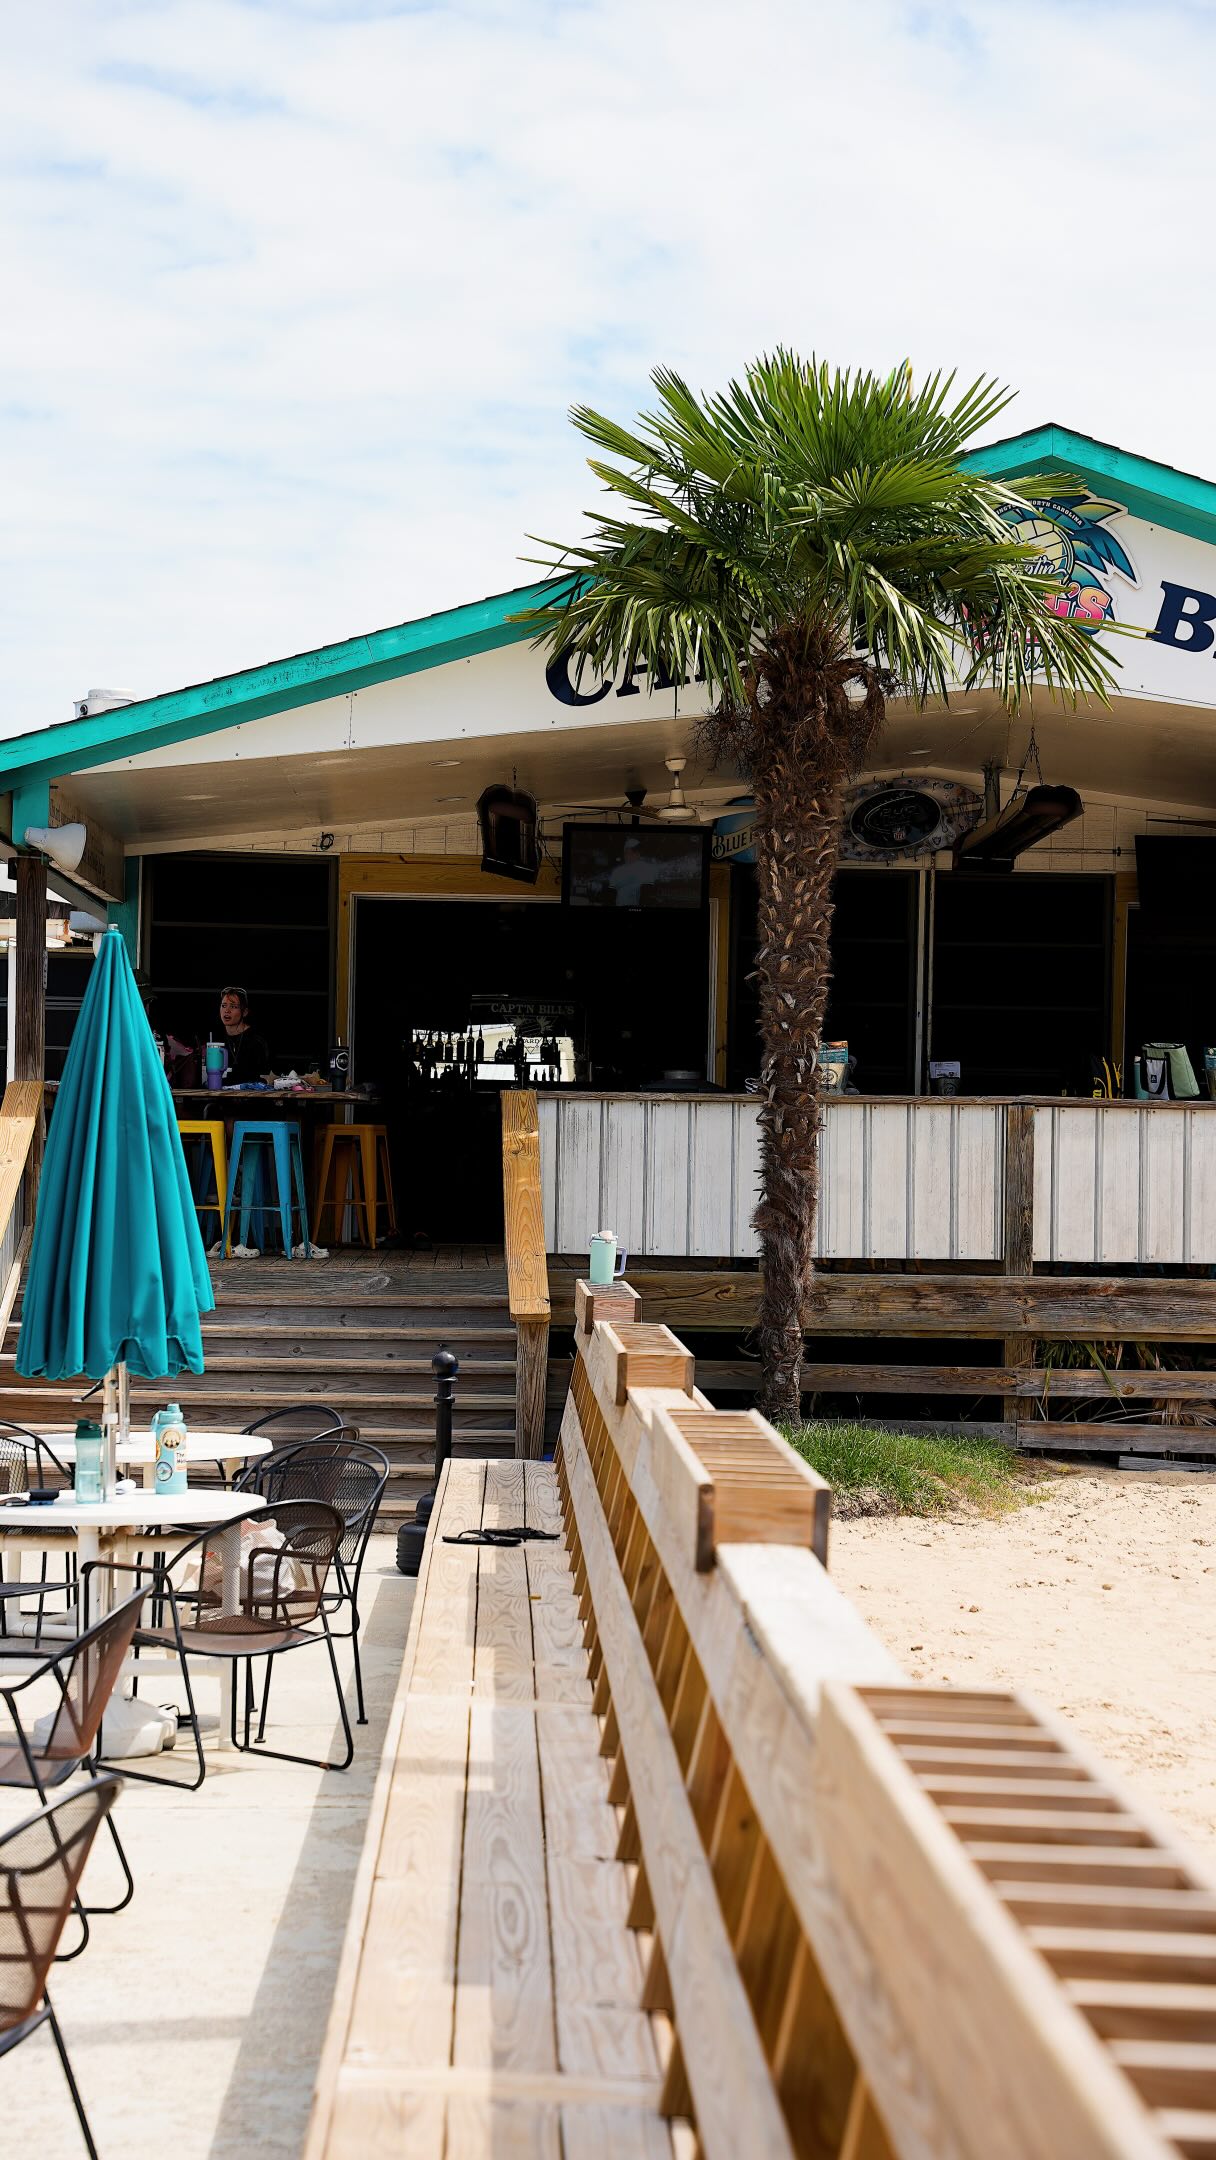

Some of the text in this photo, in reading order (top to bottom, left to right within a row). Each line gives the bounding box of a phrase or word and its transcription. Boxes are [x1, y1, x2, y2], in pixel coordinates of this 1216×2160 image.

[1052, 503, 1083, 526] CAROLINA
[1146, 580, 1216, 658] B
[712, 831, 747, 858] BLUE
[491, 1003, 575, 1014] CAPT'N BILL'S
